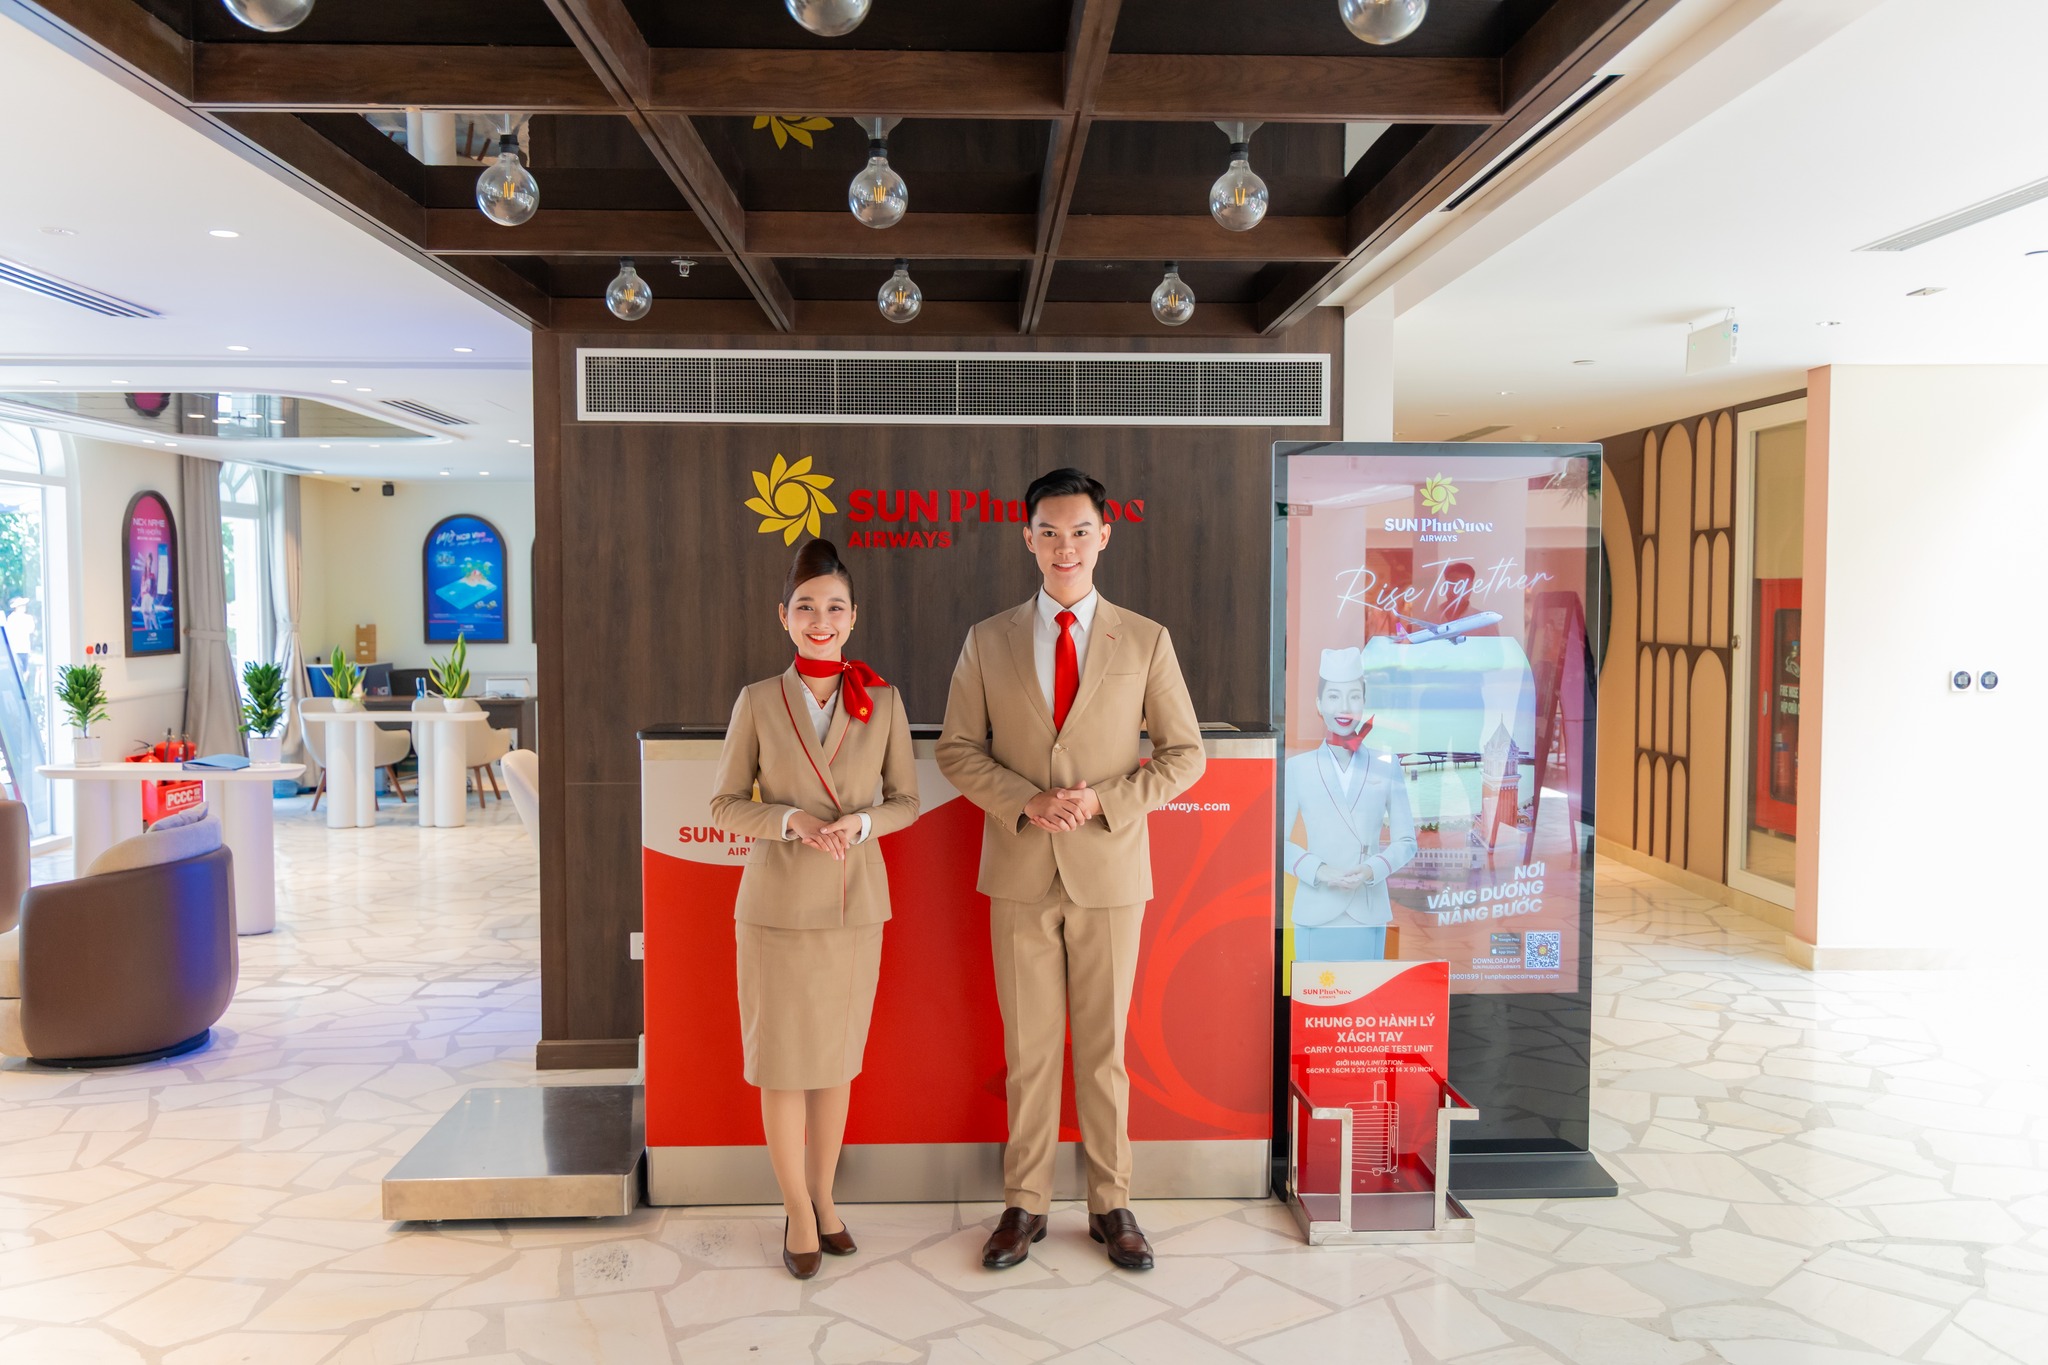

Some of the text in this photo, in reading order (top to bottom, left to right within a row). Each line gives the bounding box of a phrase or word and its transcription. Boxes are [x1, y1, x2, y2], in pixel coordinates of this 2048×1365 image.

[848, 488, 1144, 523] SUN Phuoc
[1384, 518, 1493, 533] SUN PhuQuoc
[848, 531, 951, 549] AIRWAYS
[1336, 556, 1554, 620] Rise Together
[167, 790, 193, 807] PCCC
[678, 826, 724, 843] SUN
[1514, 860, 1545, 880] NƠI
[1427, 880, 1544, 909] VẦNG DƯƠNG
[1438, 896, 1542, 926] NÂNG BƯỚC
[1305, 1013, 1435, 1028] KHUNG ĐO HÀNH LÝ
[1337, 1029, 1403, 1042] XÁCH TAY
